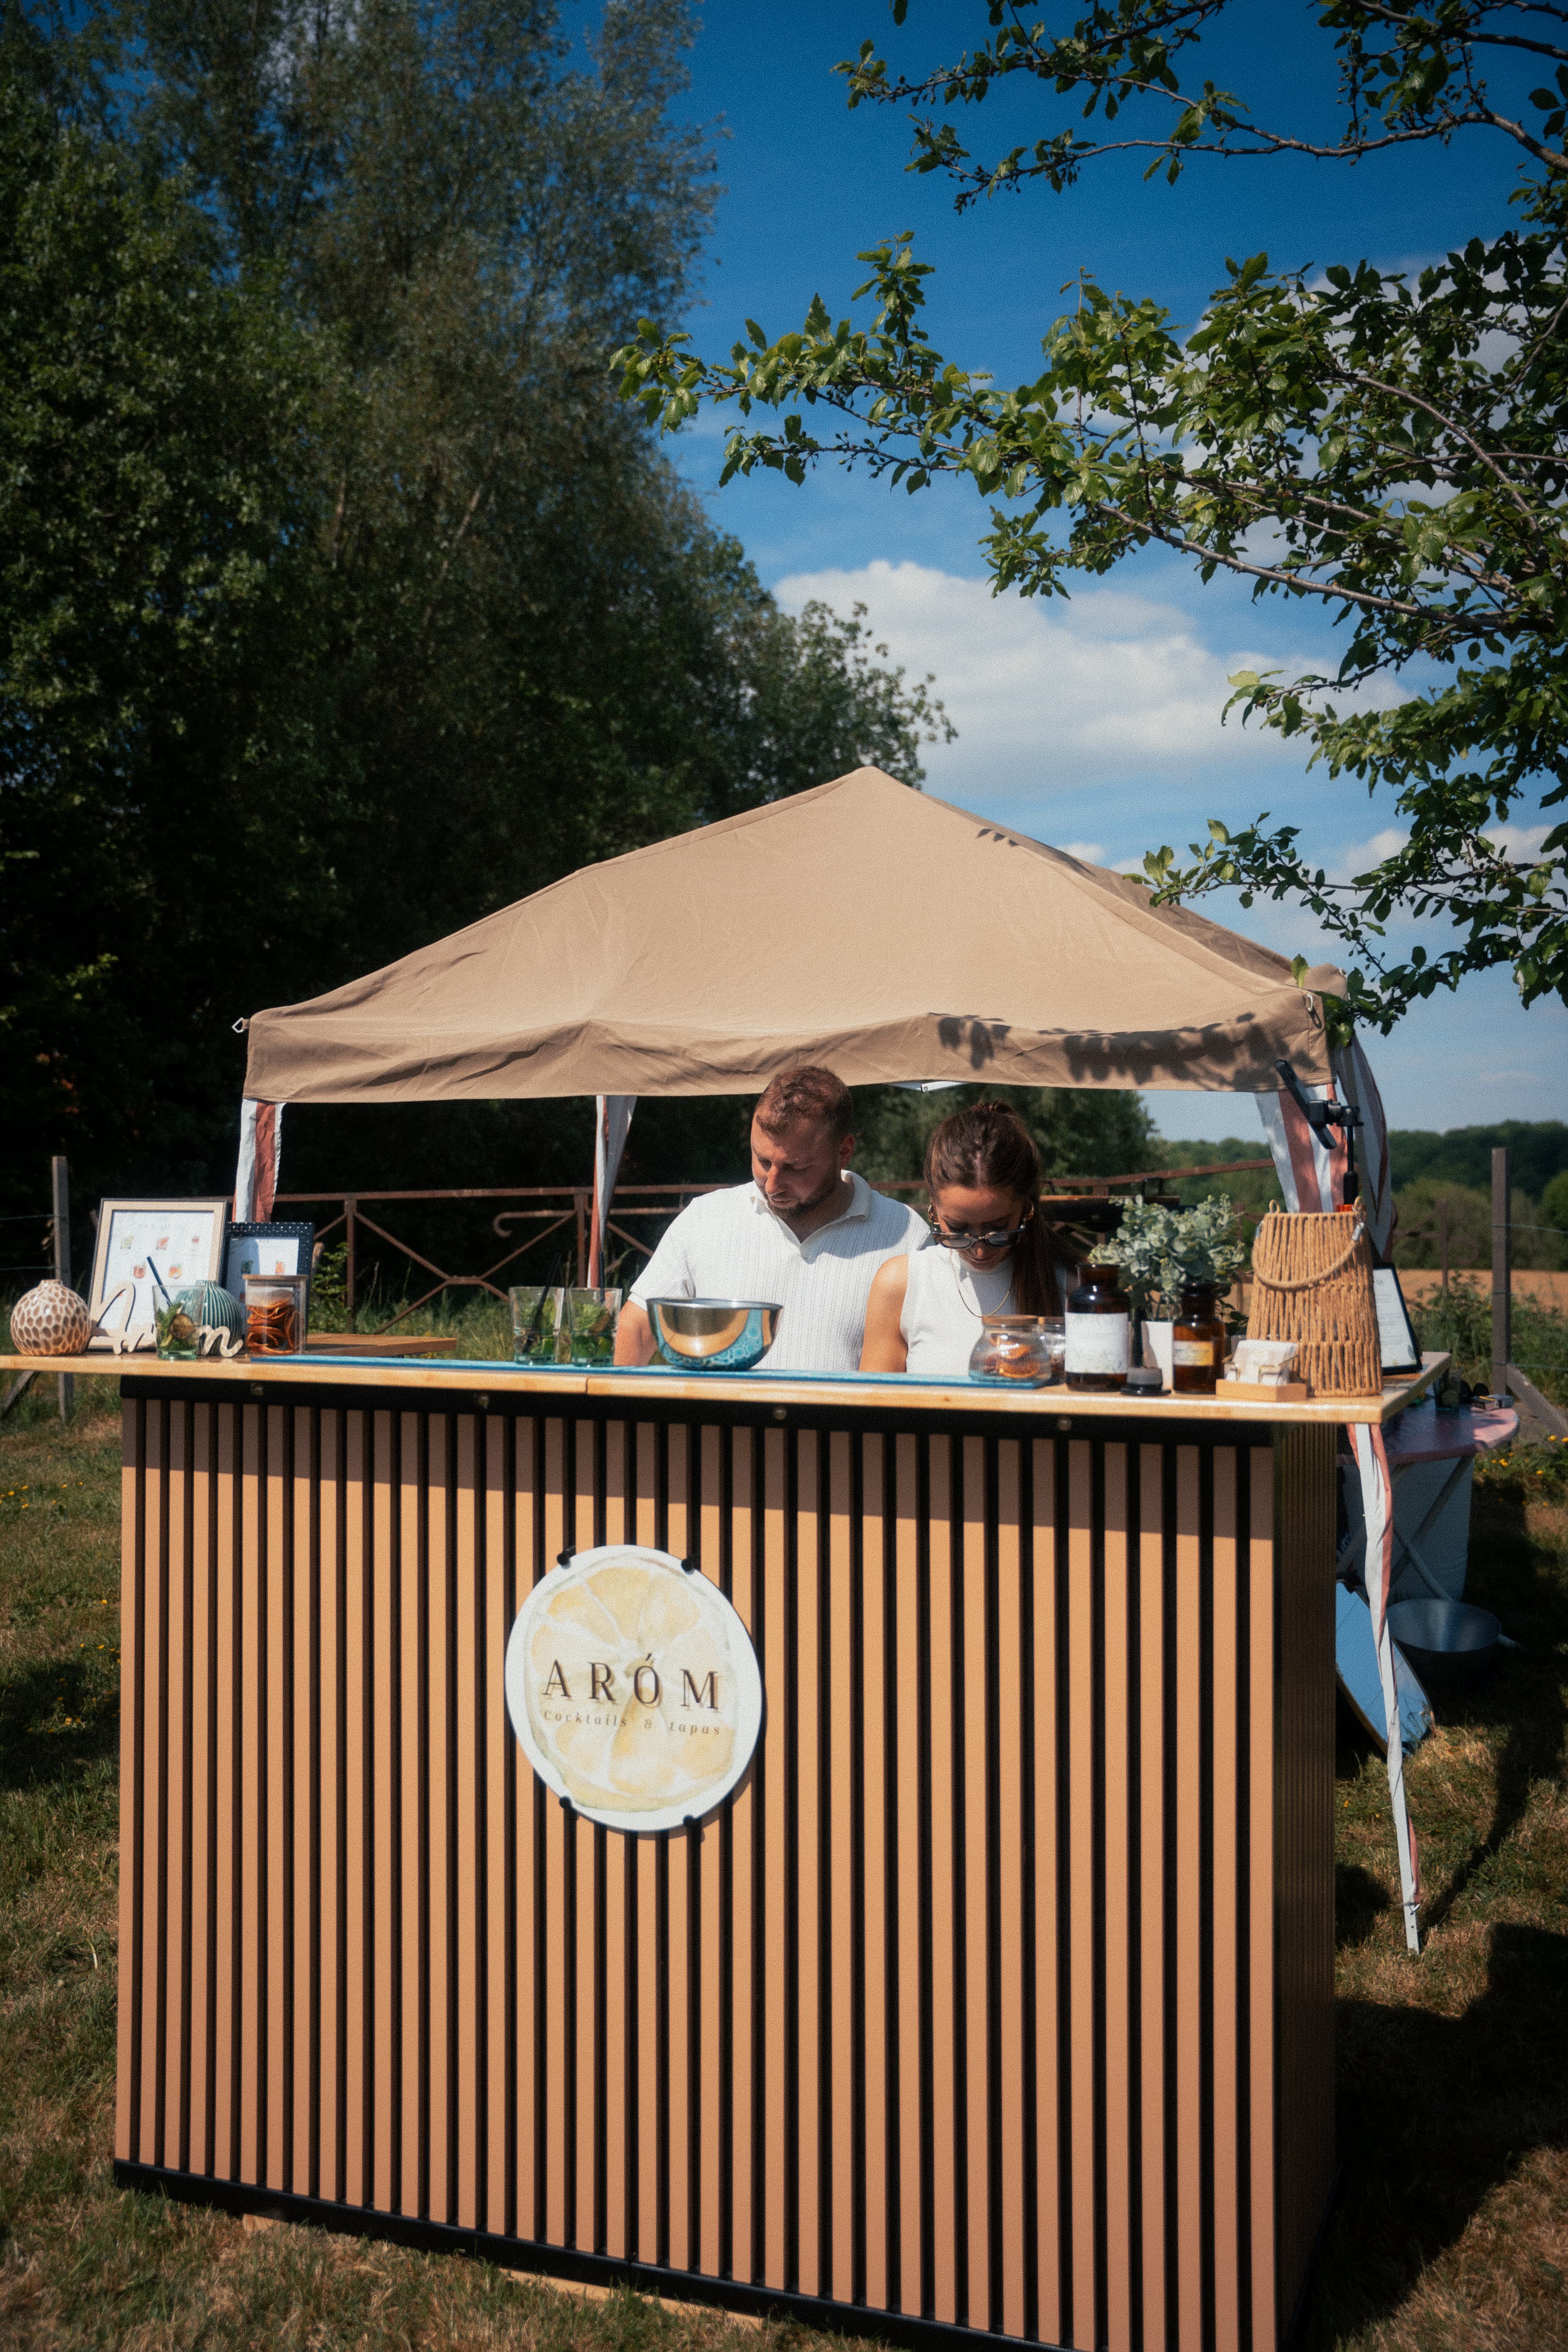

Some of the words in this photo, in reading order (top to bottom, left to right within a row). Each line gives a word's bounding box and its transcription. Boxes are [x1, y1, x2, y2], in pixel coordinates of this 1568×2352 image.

[542, 1653, 719, 1710] ARÓM
[544, 1710, 627, 1727] Cocktails
[670, 1722, 719, 1735] tapas
